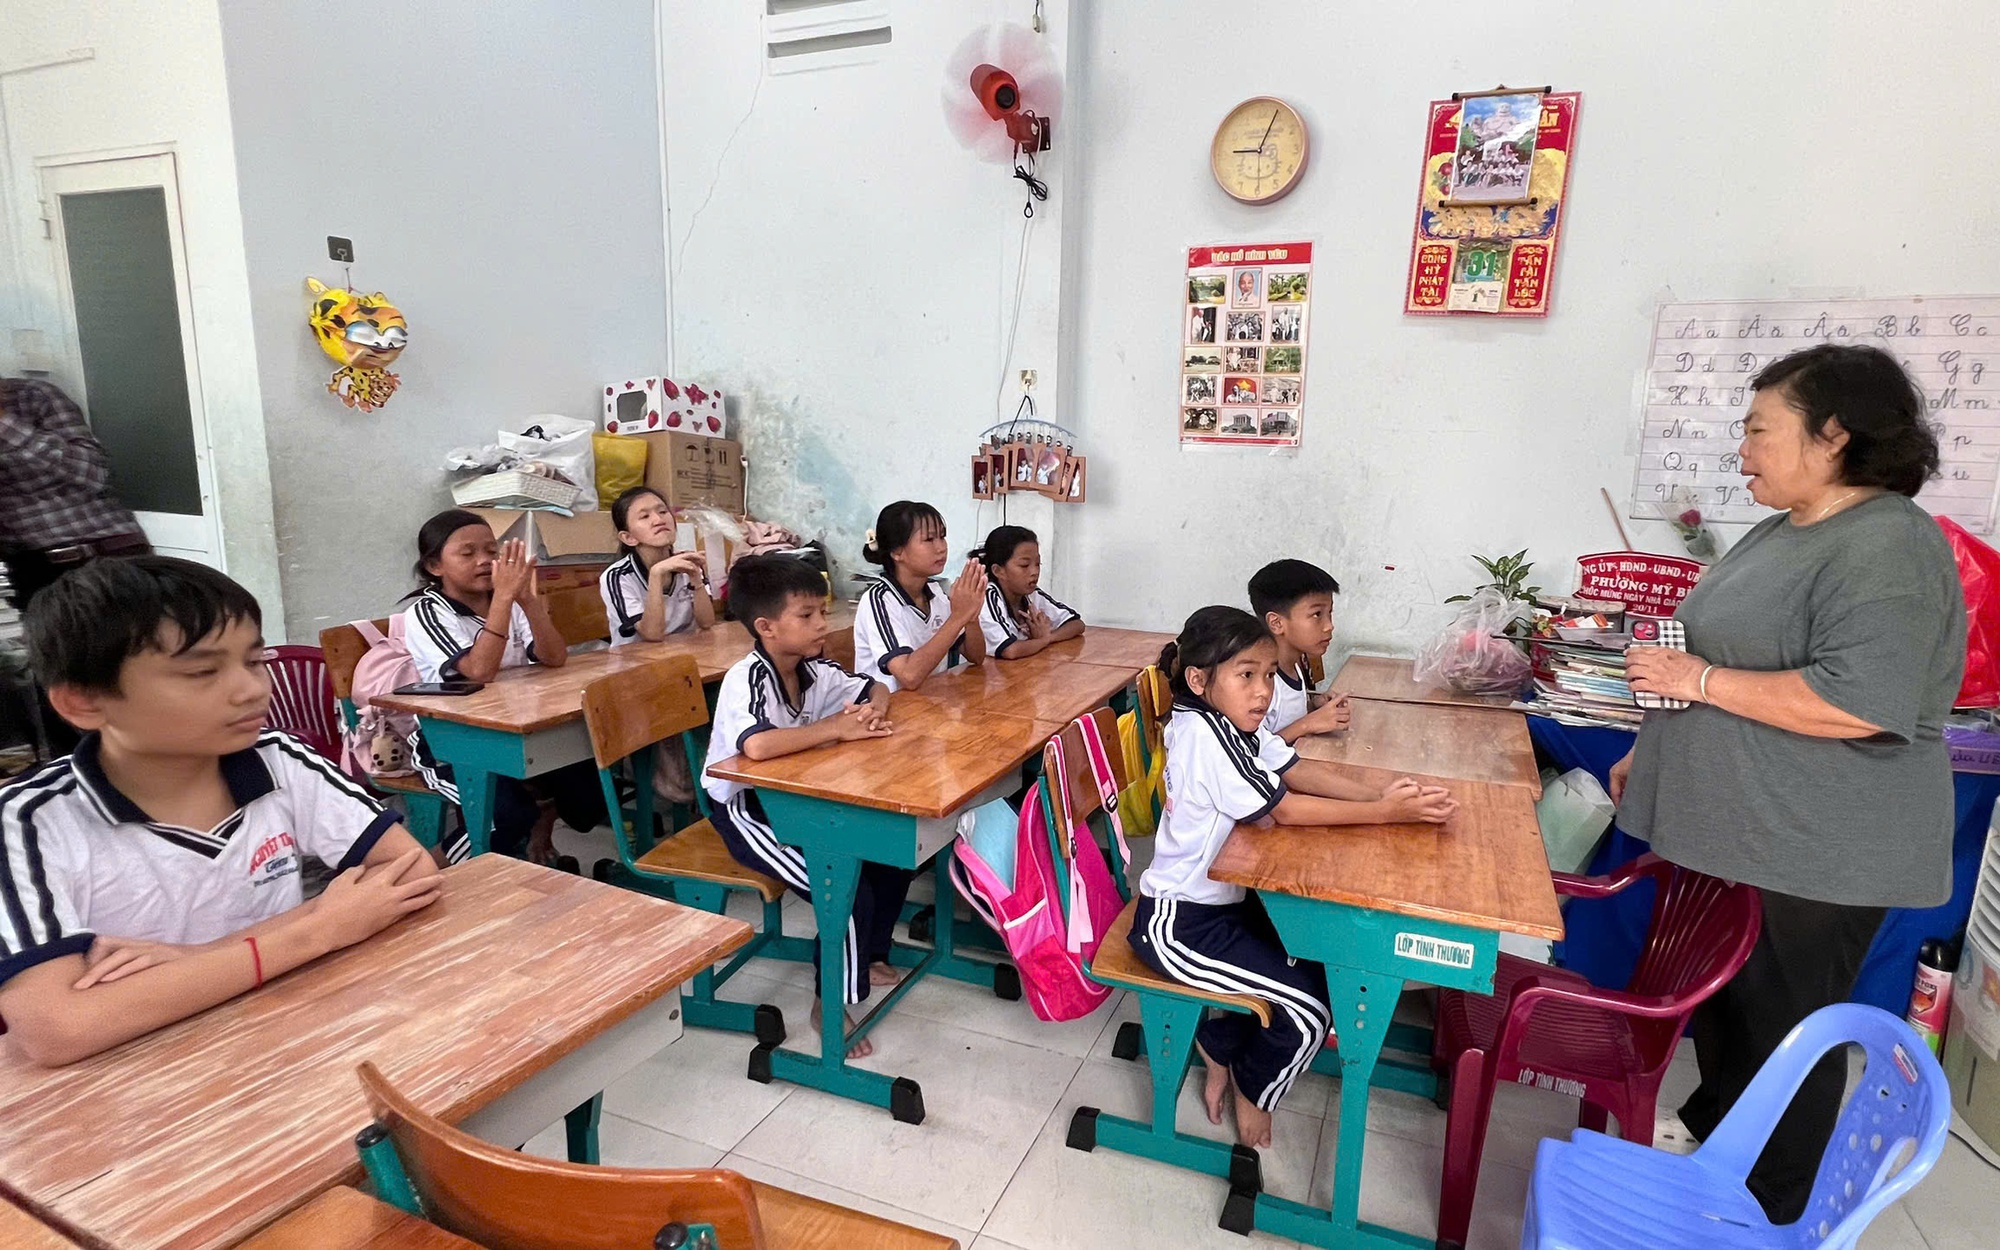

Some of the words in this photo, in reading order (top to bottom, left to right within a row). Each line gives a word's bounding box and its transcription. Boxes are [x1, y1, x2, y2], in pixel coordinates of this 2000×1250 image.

[1467, 250, 1497, 277] 31
[1675, 318, 1700, 339] A
[1706, 329, 1719, 339] a
[1804, 311, 1832, 338] Â
[1875, 315, 1898, 337] B
[1906, 315, 1921, 337] b
[1950, 314, 1972, 336] C
[1977, 326, 1987, 336] c
[1675, 352, 1694, 373] D
[1702, 357, 1715, 373] d
[1972, 362, 1985, 385] g
[1698, 386, 1711, 406] h
[1930, 388, 1959, 409] M
[1965, 399, 1989, 410] m
[1662, 419, 1691, 439] N
[1692, 430, 1708, 439] n
[1663, 451, 1683, 472] Q
[1689, 463, 1698, 478] q
[1715, 485, 1739, 505] V
[1653, 564, 1681, 578] UBND
[1651, 583, 1674, 596] MỸ
[1632, 604, 1658, 614] 20/11
[1397, 934, 1414, 954] LỚP
[1416, 937, 1435, 958] TÌNH
[1518, 1067, 1535, 1085] LỚP
[1535, 1071, 1554, 1091] TÌNH
